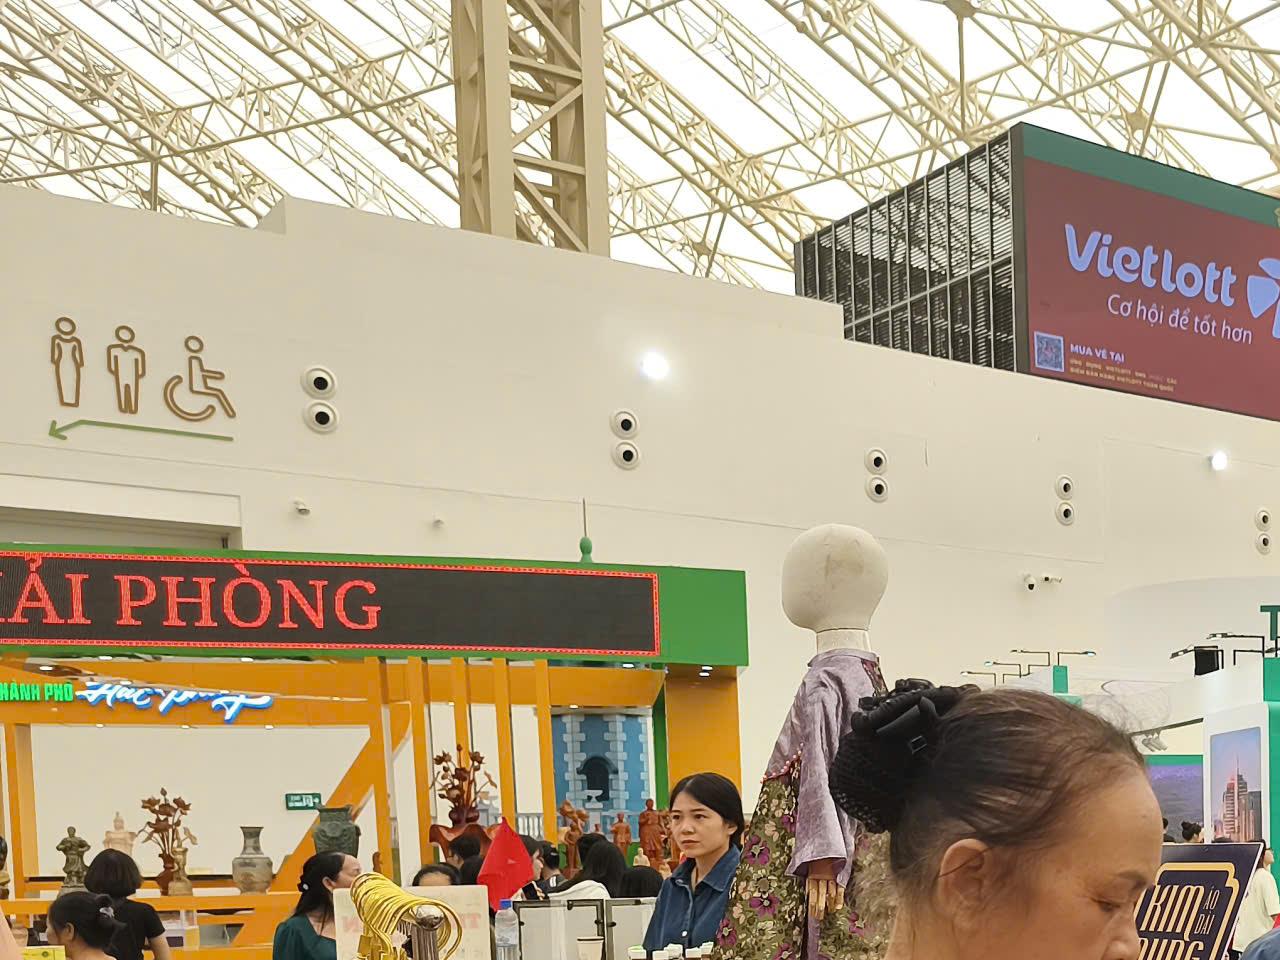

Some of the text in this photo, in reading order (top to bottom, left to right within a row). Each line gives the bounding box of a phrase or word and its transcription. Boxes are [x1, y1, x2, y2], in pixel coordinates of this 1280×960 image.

[1064, 223, 1237, 307] Vietlott
[1107, 294, 1252, 344] Cơ hội để tốt hơn
[1070, 344, 1092, 357] MUA
[0, 552, 381, 630] ẢI PHÒNG
[1140, 884, 1205, 941] KIM
[1194, 911, 1216, 935] DÀI
[1203, 886, 1220, 911] ÁO
